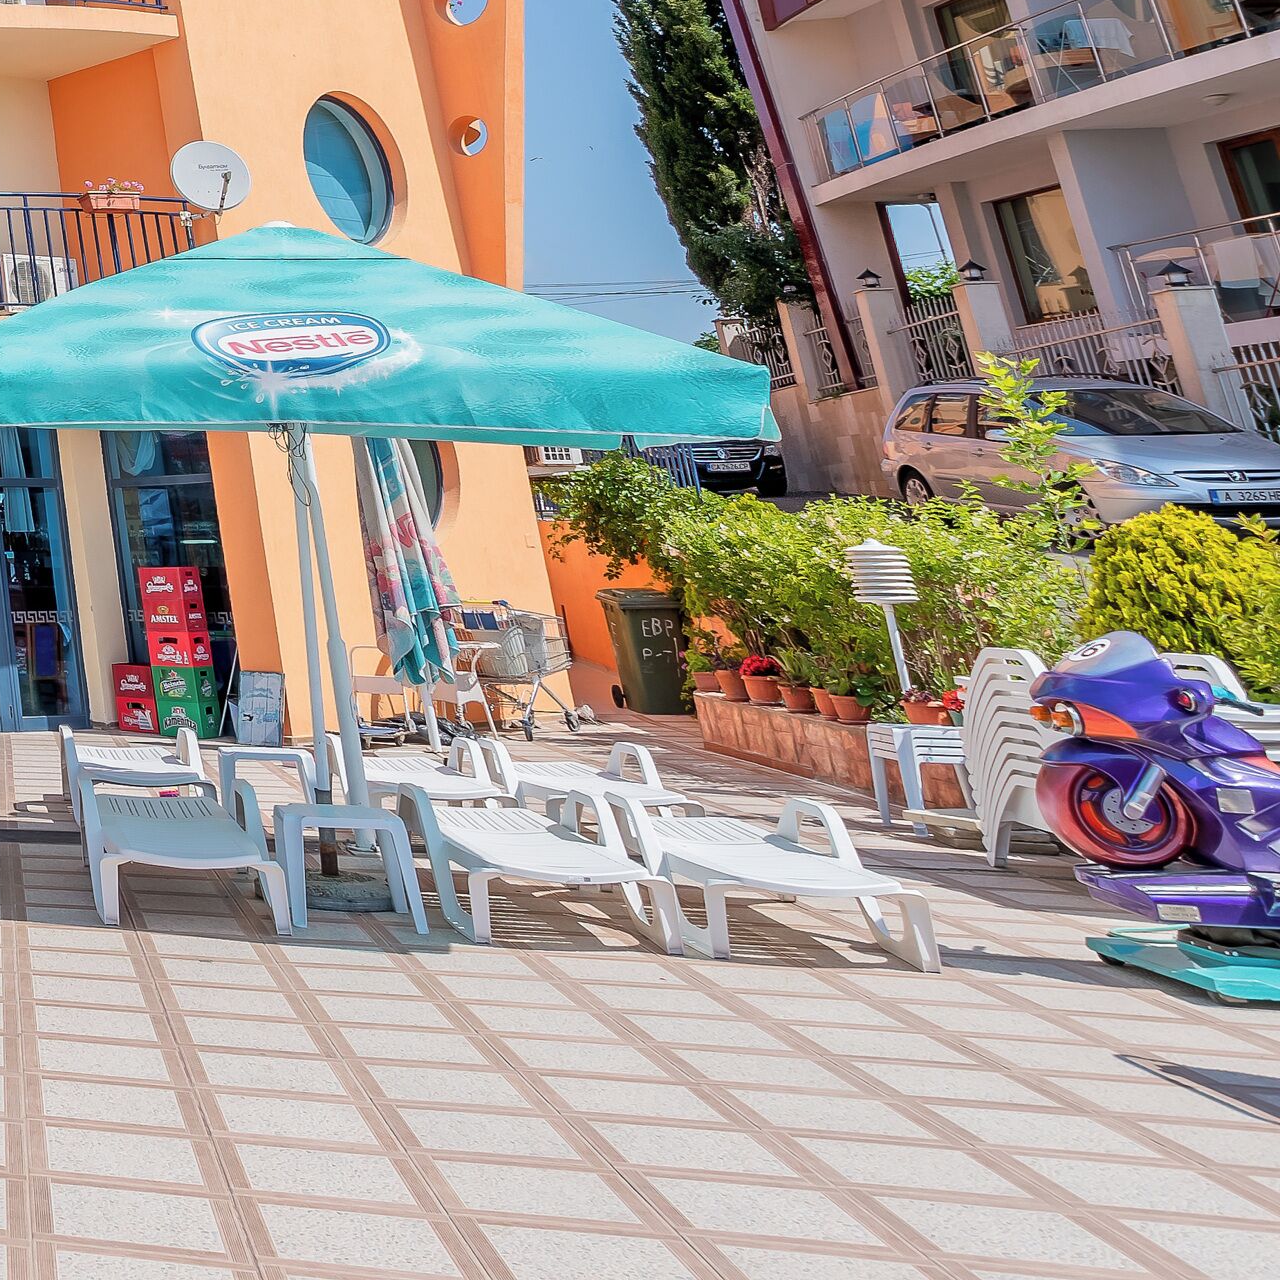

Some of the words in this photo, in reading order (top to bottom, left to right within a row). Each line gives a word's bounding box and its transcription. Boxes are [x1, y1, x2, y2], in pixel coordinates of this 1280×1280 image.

[228, 320, 258, 333] ICE
[263, 316, 342, 328] CREAM
[1224, 492, 1233, 502] A
[150, 614, 179, 624] AMSTEL
[1073, 641, 1106, 657] 16
